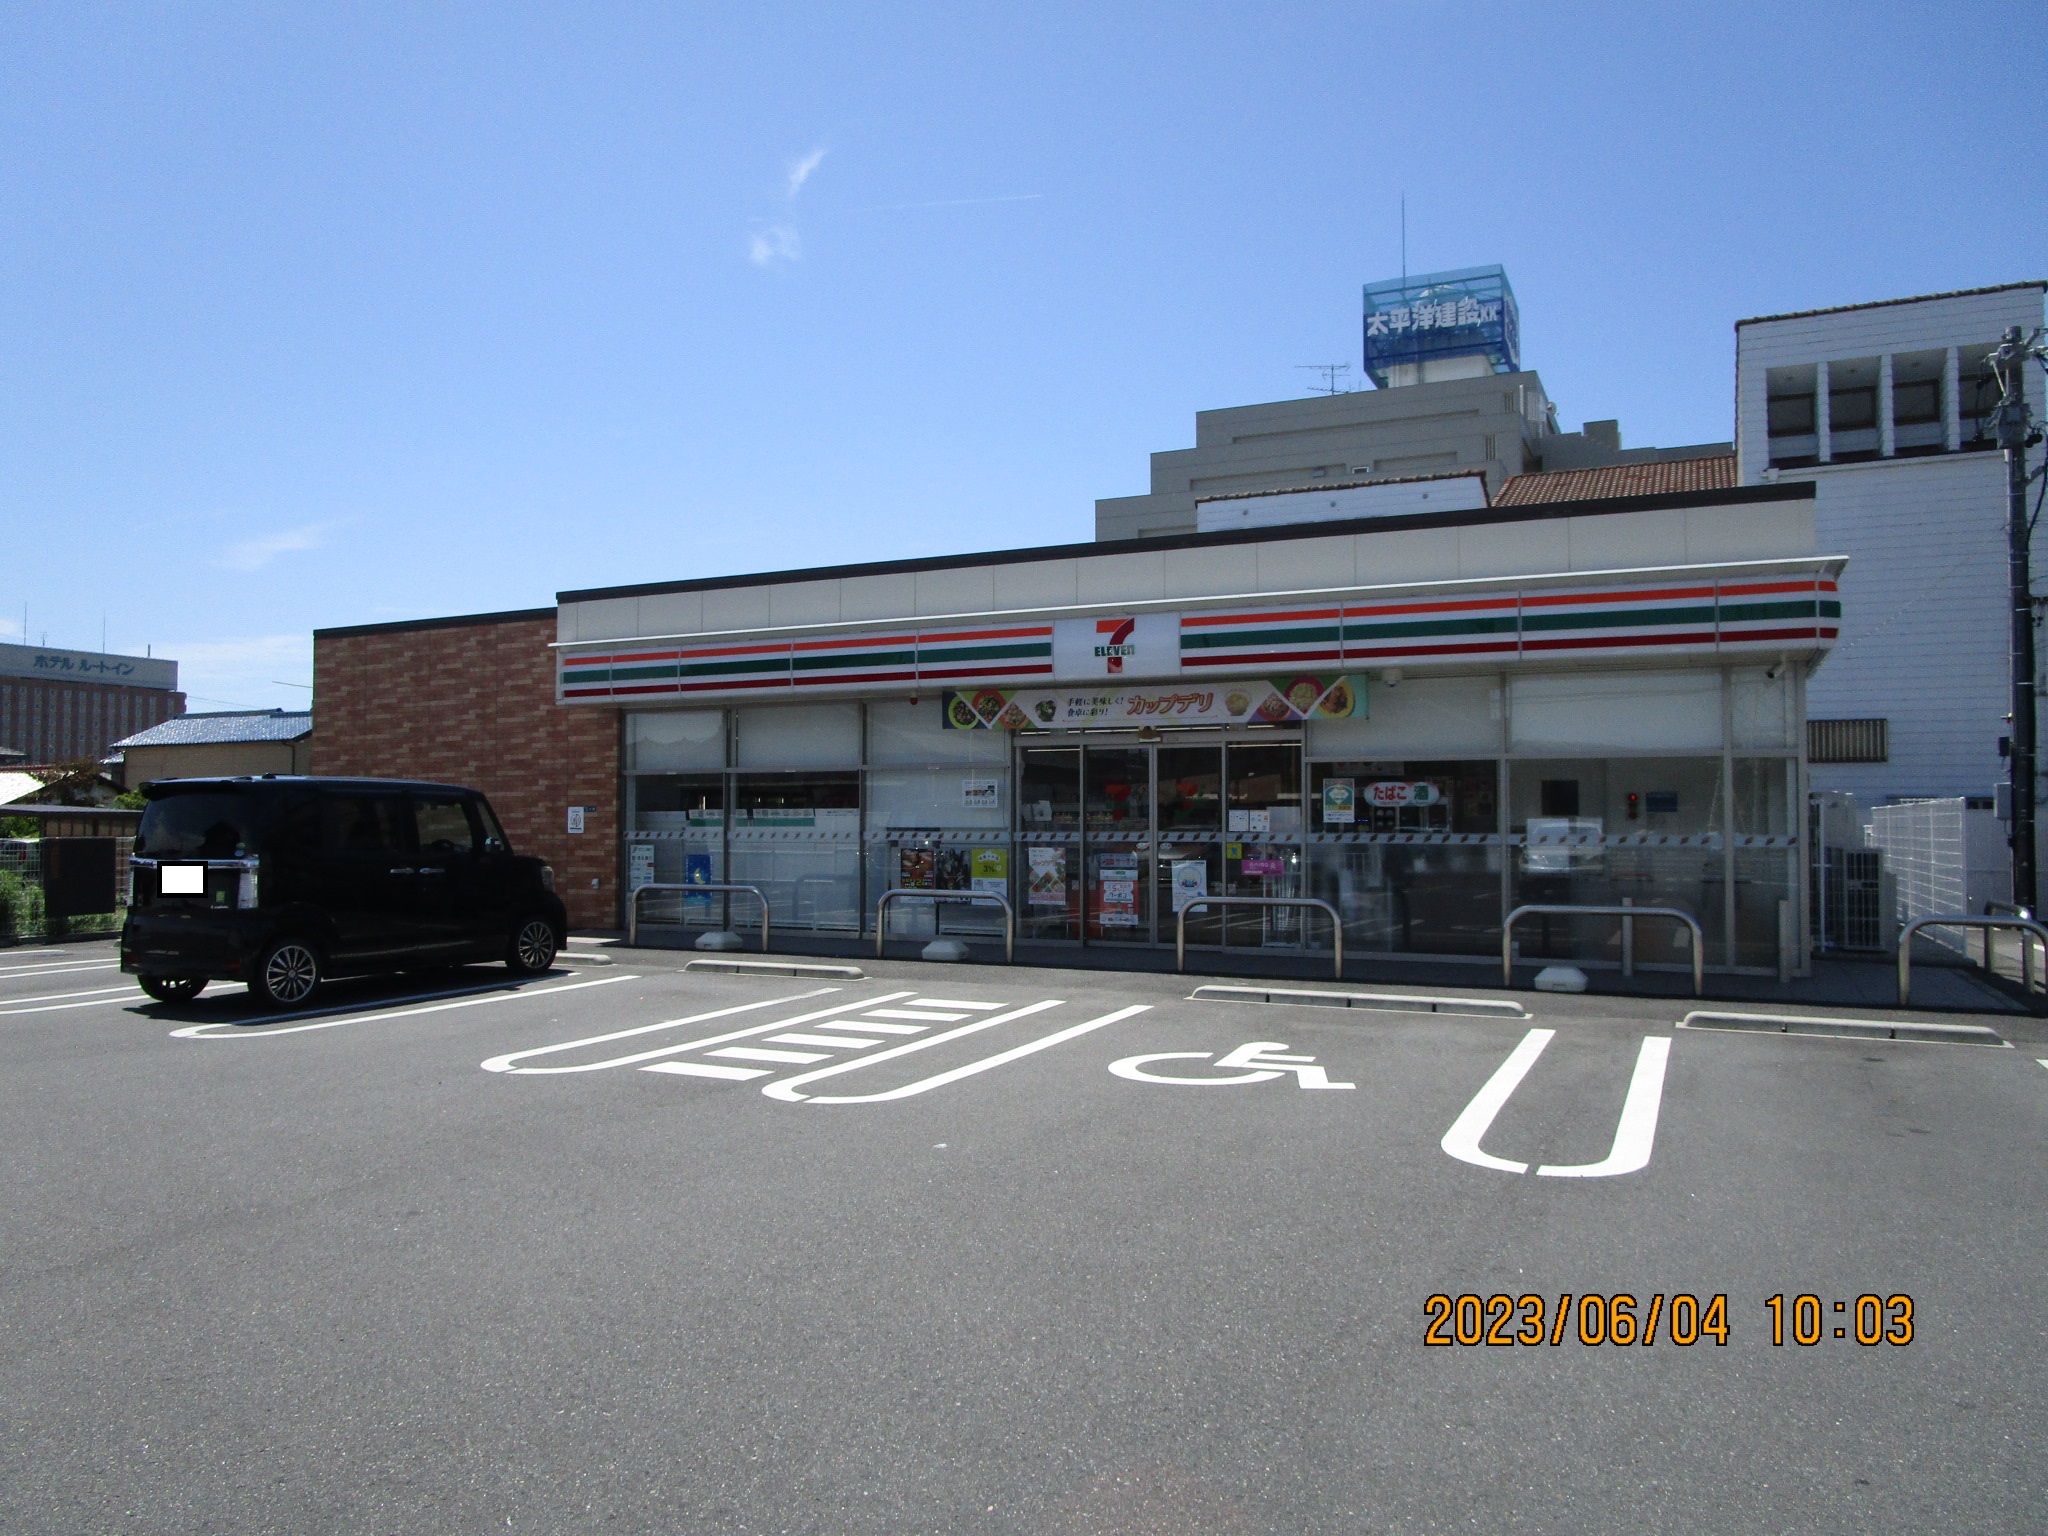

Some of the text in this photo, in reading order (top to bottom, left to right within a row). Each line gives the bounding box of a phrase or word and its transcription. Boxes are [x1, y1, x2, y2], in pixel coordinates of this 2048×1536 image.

[1096, 617, 1135, 673] 7
[33, 655, 136, 675] ホテル ルートイン
[1127, 692, 1214, 715] カップデリ
[1373, 785, 1407, 801] たばこ
